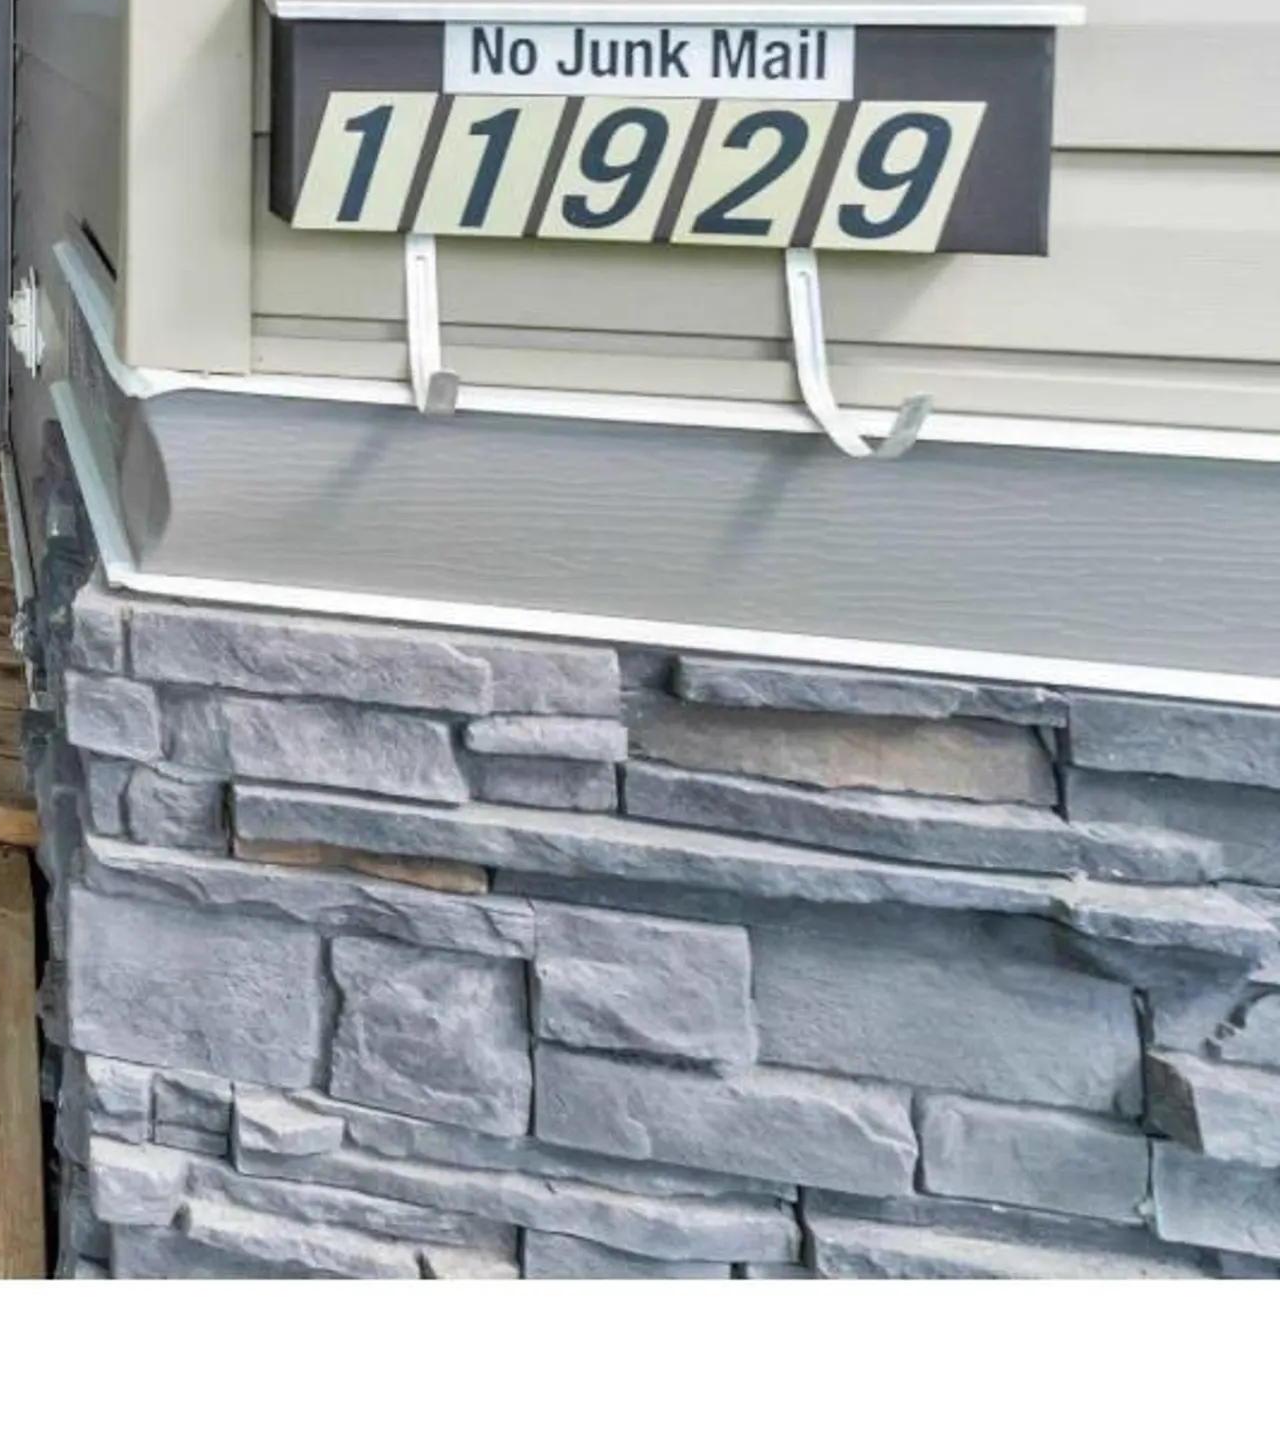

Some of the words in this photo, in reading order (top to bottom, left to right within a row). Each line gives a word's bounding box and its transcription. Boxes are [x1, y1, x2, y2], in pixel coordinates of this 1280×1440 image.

[471, 27, 538, 77] No
[556, 29, 691, 80] Junk
[711, 30, 827, 81] Mail
[336, 104, 953, 239] 11929
